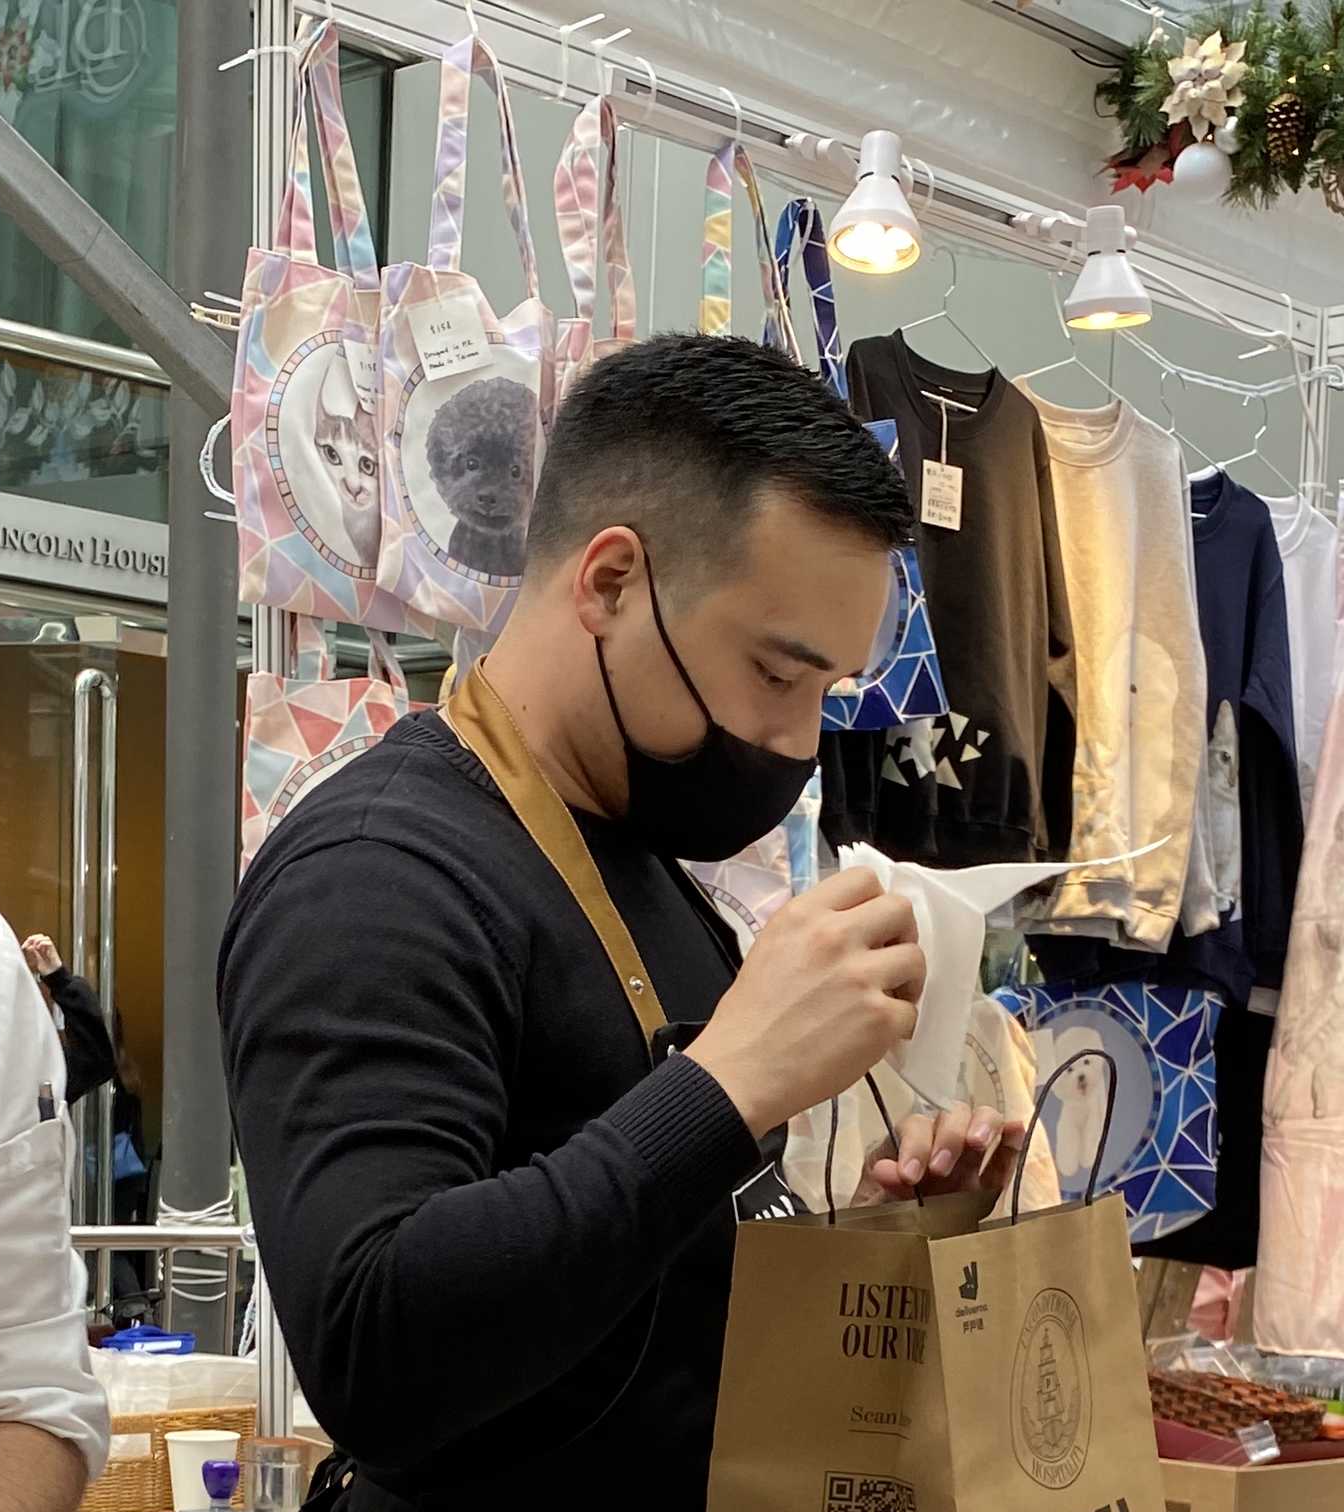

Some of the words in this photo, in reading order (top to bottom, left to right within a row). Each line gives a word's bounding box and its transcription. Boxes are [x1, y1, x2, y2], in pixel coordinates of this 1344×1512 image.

[430, 320, 452, 335] $158
[841, 1323, 899, 1360] OUR
[849, 1405, 898, 1425] Scan
